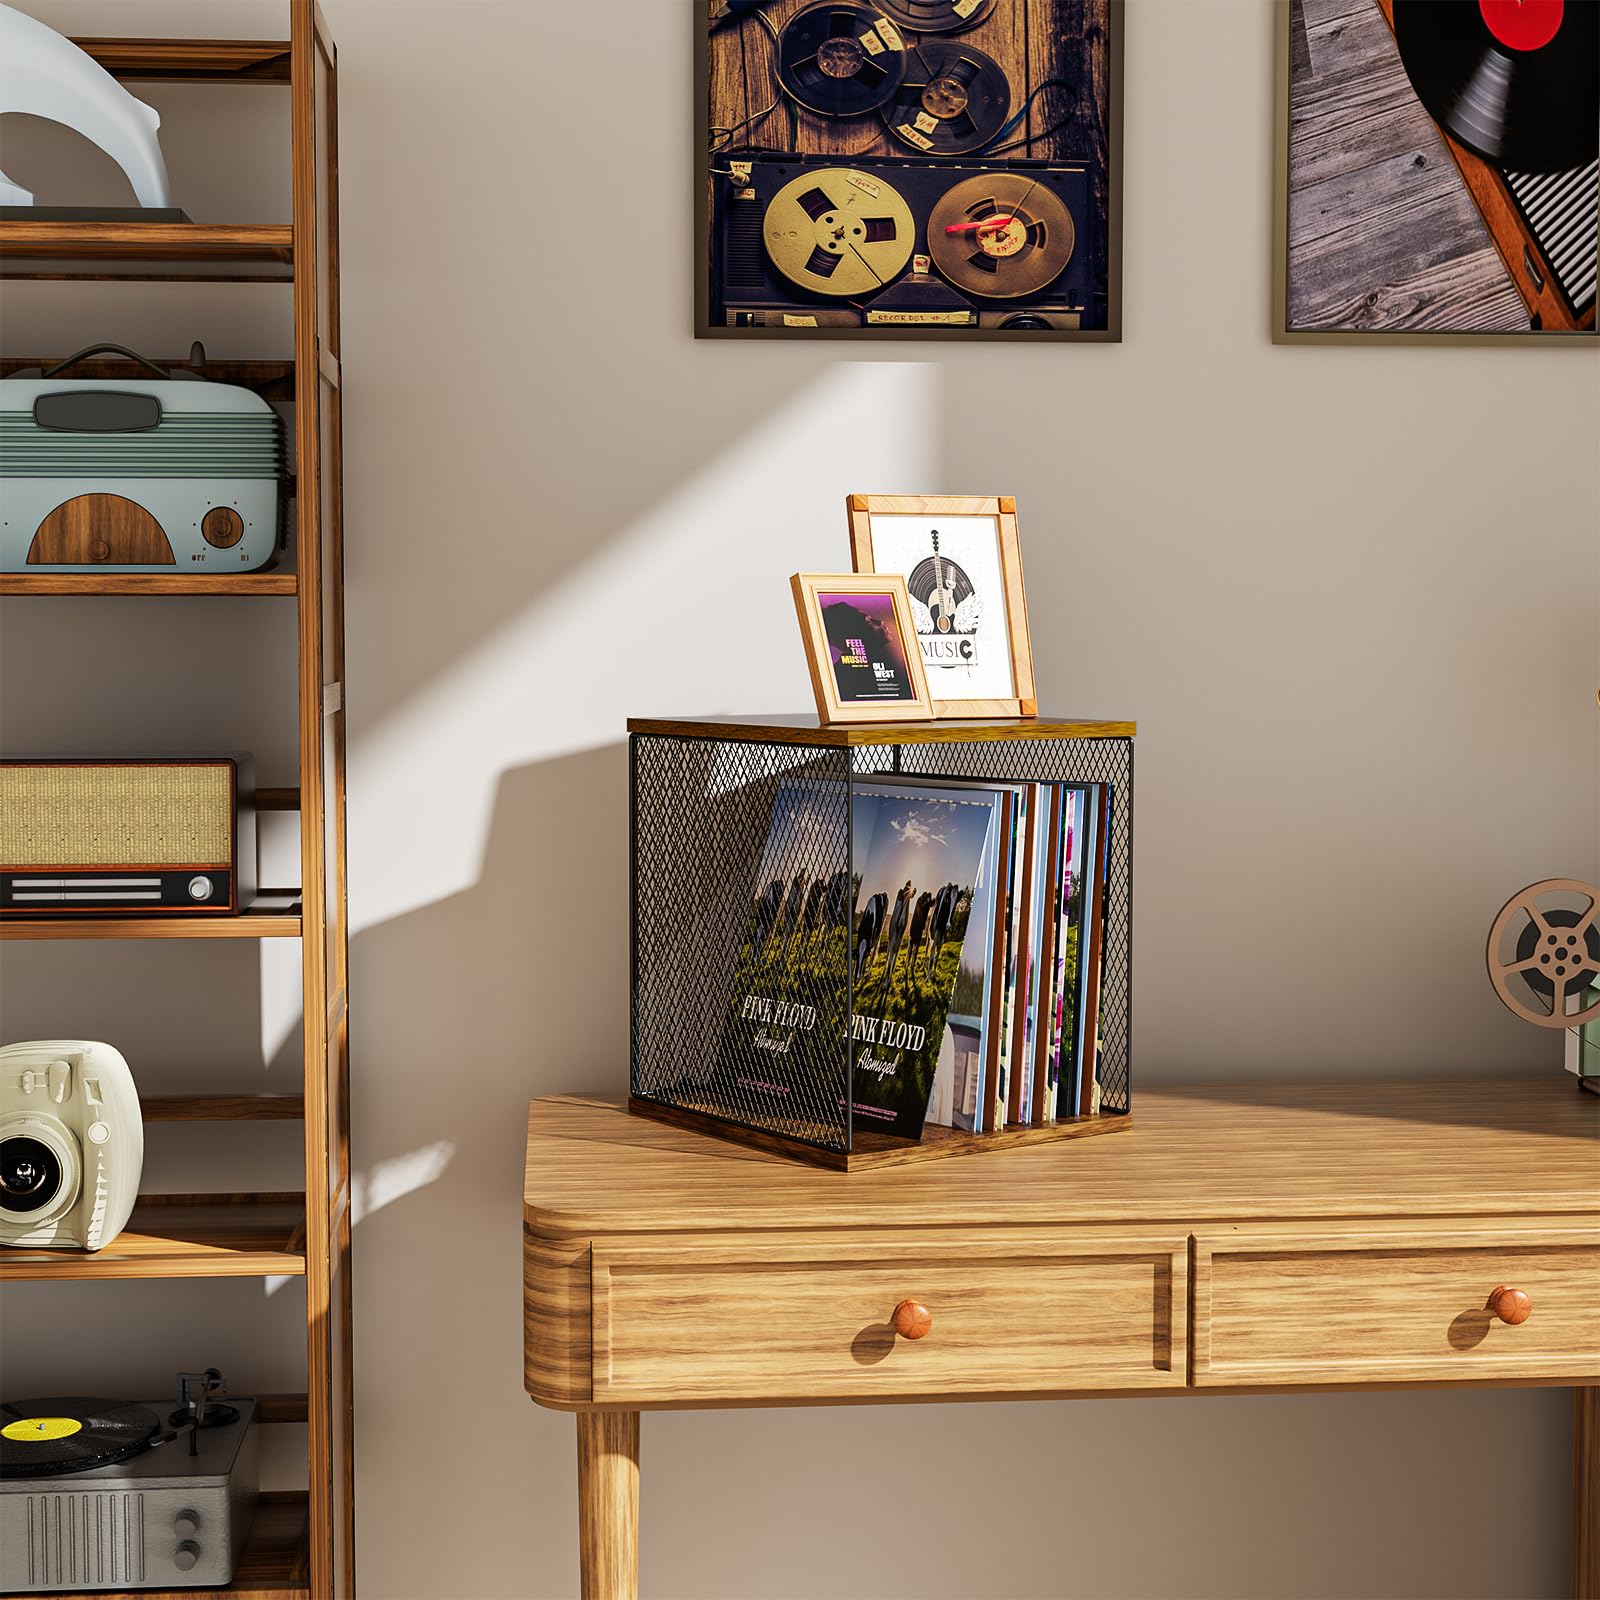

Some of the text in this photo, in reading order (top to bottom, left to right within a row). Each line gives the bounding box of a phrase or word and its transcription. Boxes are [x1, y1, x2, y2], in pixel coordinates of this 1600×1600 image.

[846, 639, 864, 647] FEEL
[850, 647, 866, 655] THE
[920, 639, 973, 660] MUSIC
[841, 655, 868, 664] MUSIC
[874, 670, 894, 678] WEST
[877, 1019, 926, 1051] FLOYD
[856, 1047, 900, 1082] Atomized
